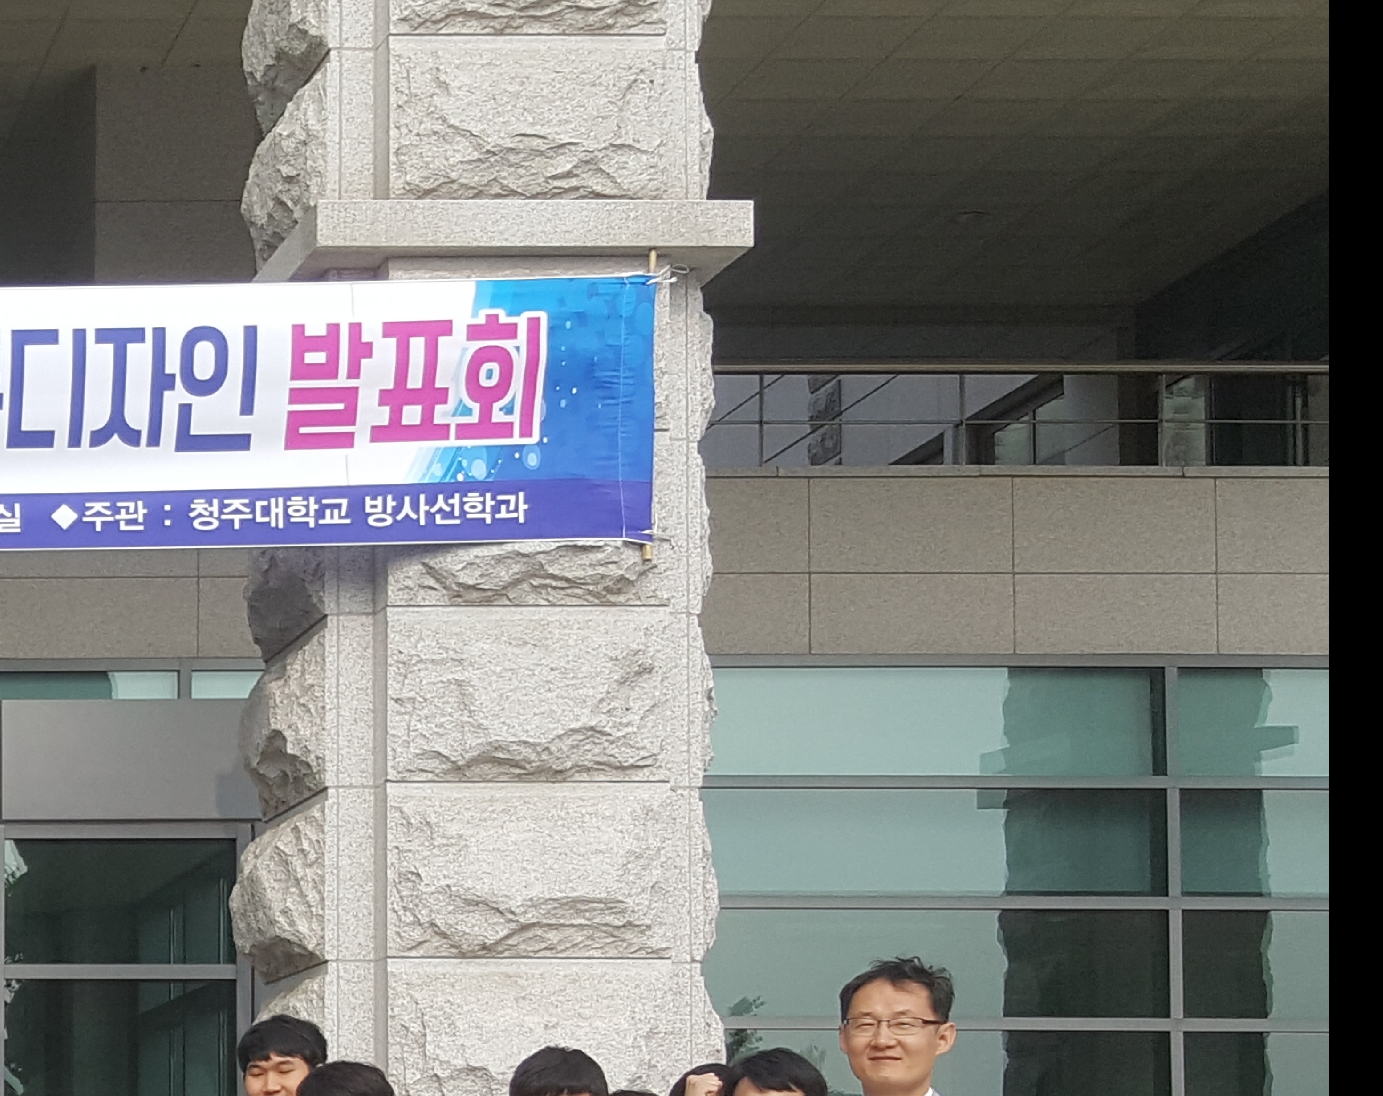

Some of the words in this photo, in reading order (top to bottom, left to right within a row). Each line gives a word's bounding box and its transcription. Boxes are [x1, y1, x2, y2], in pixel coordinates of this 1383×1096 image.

[283, 312, 542, 452] 발표회
[81, 498, 148, 532] 주관
[188, 496, 353, 531] 청주대학교
[363, 491, 529, 529] 방사선학과
